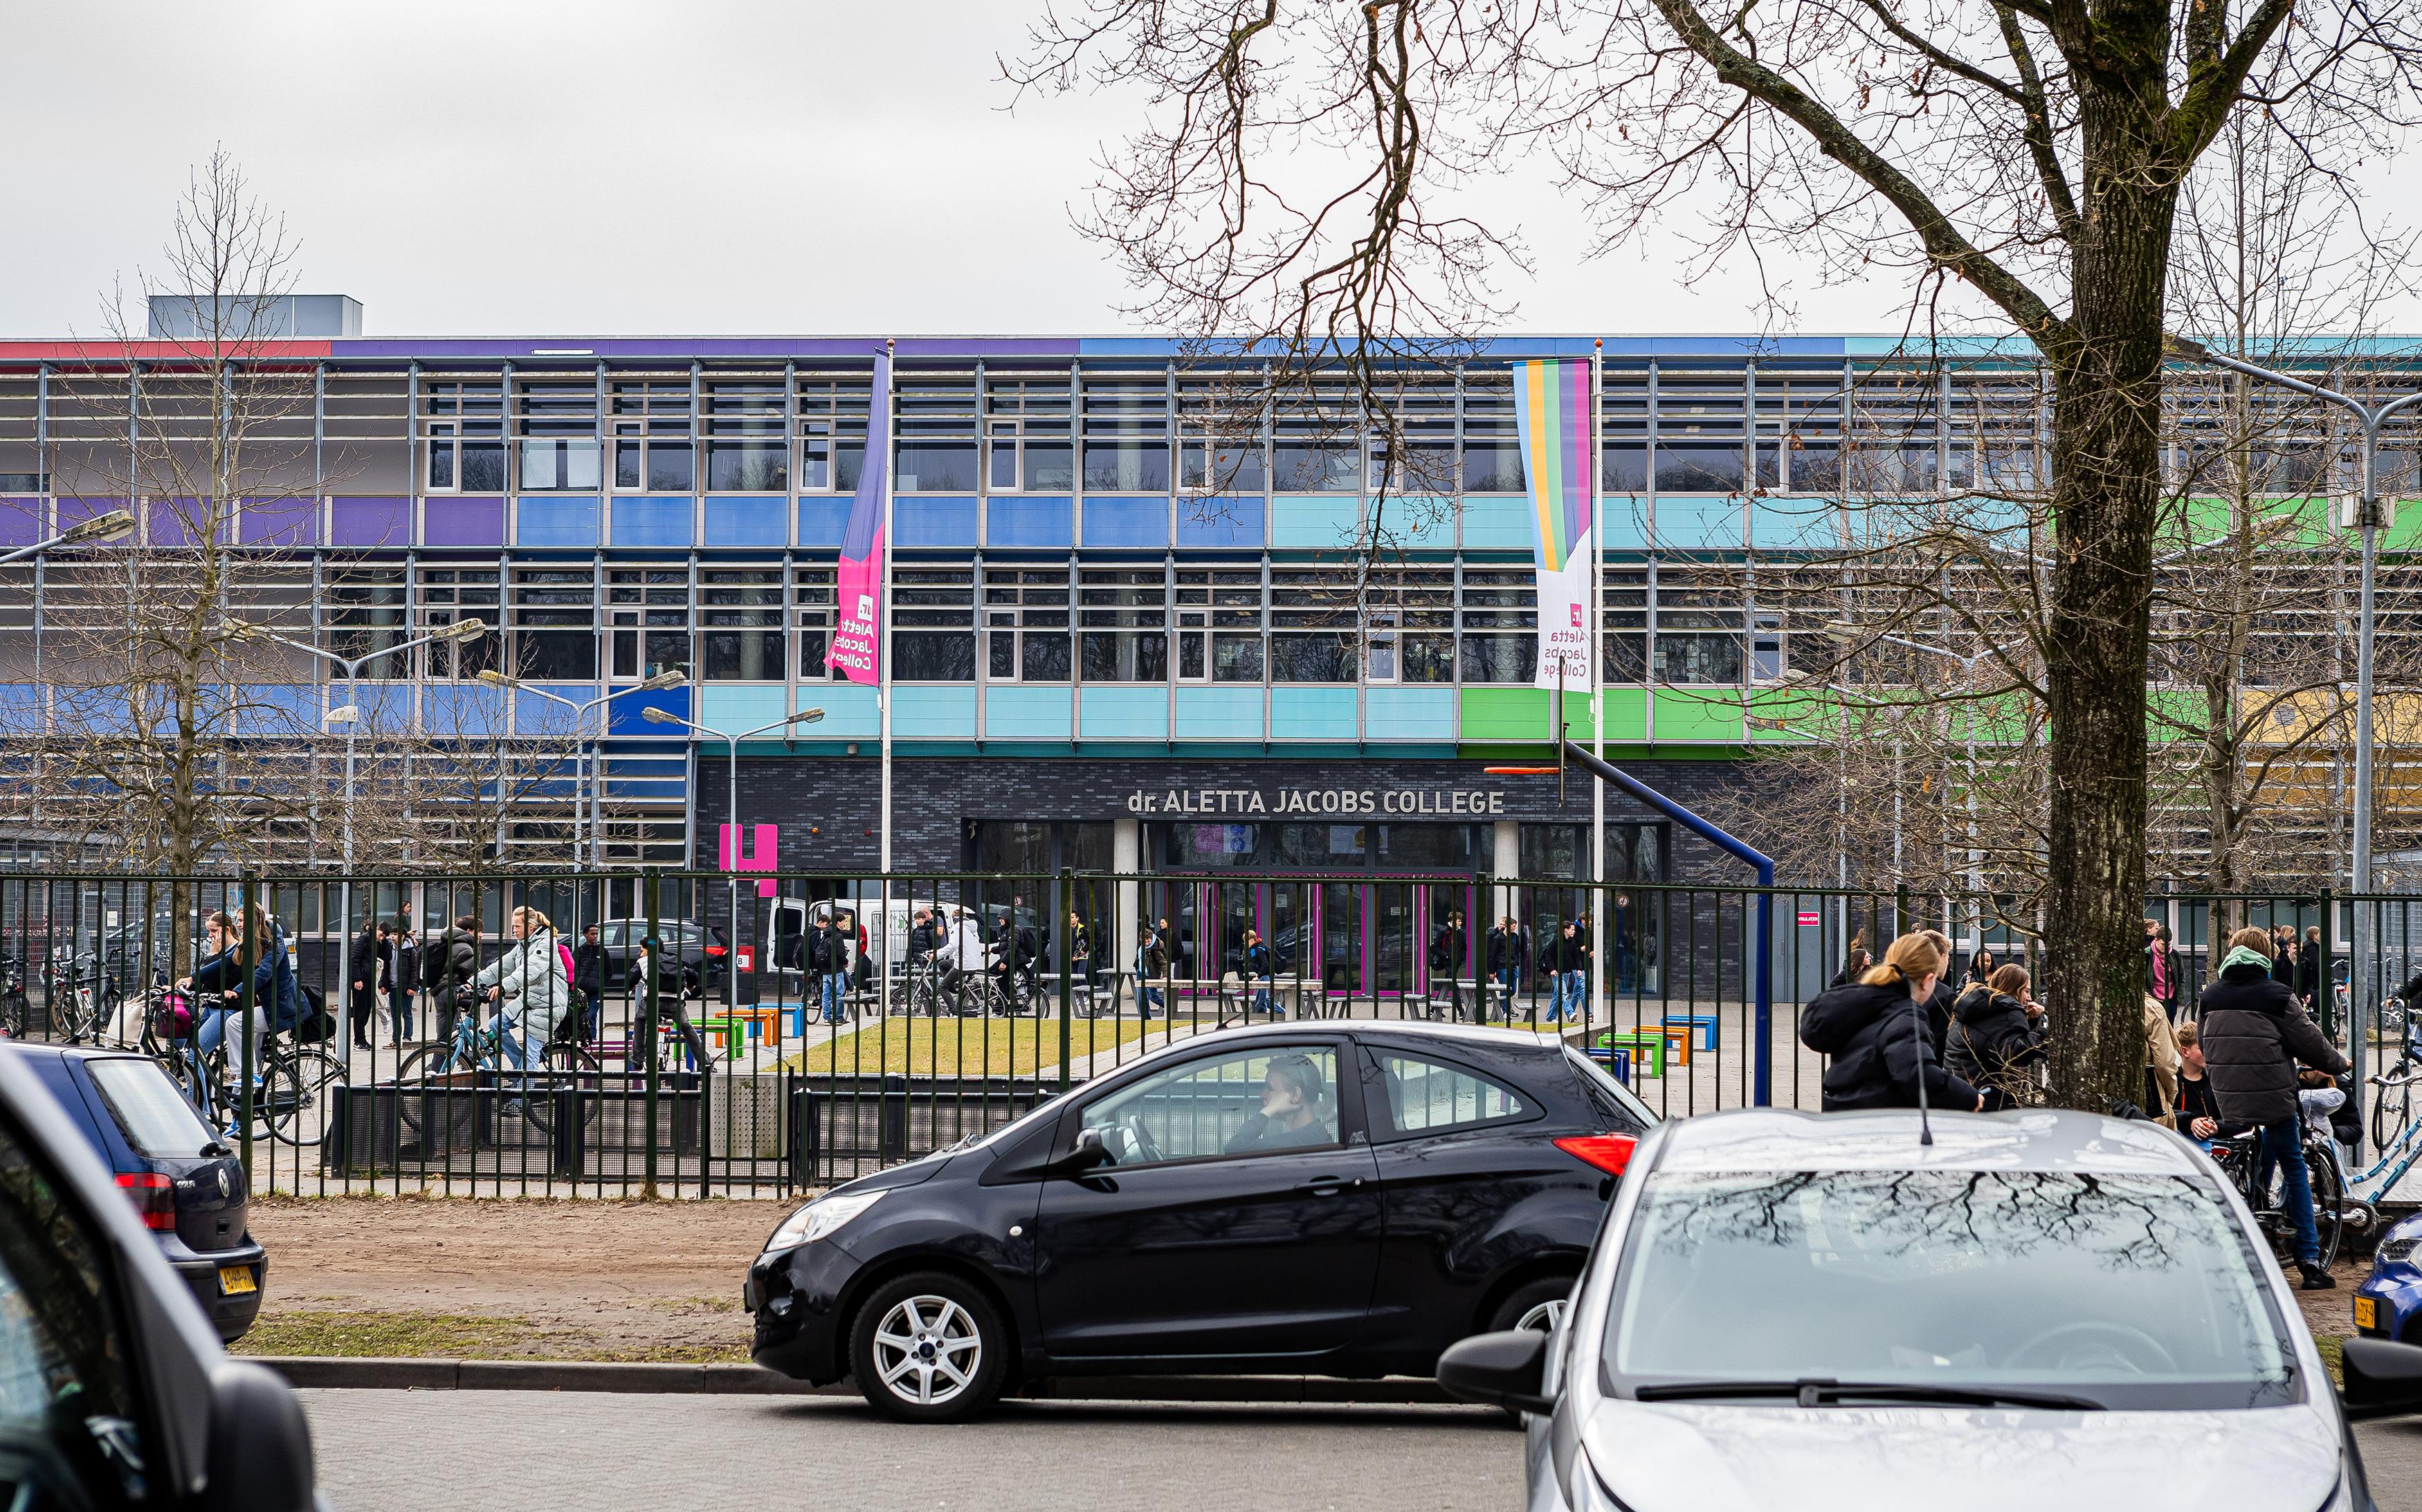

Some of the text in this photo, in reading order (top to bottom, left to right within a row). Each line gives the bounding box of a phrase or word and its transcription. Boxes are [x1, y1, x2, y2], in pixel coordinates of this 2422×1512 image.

[1128, 790, 1504, 814] dr. ALETTA JACOBS COLLEGE
